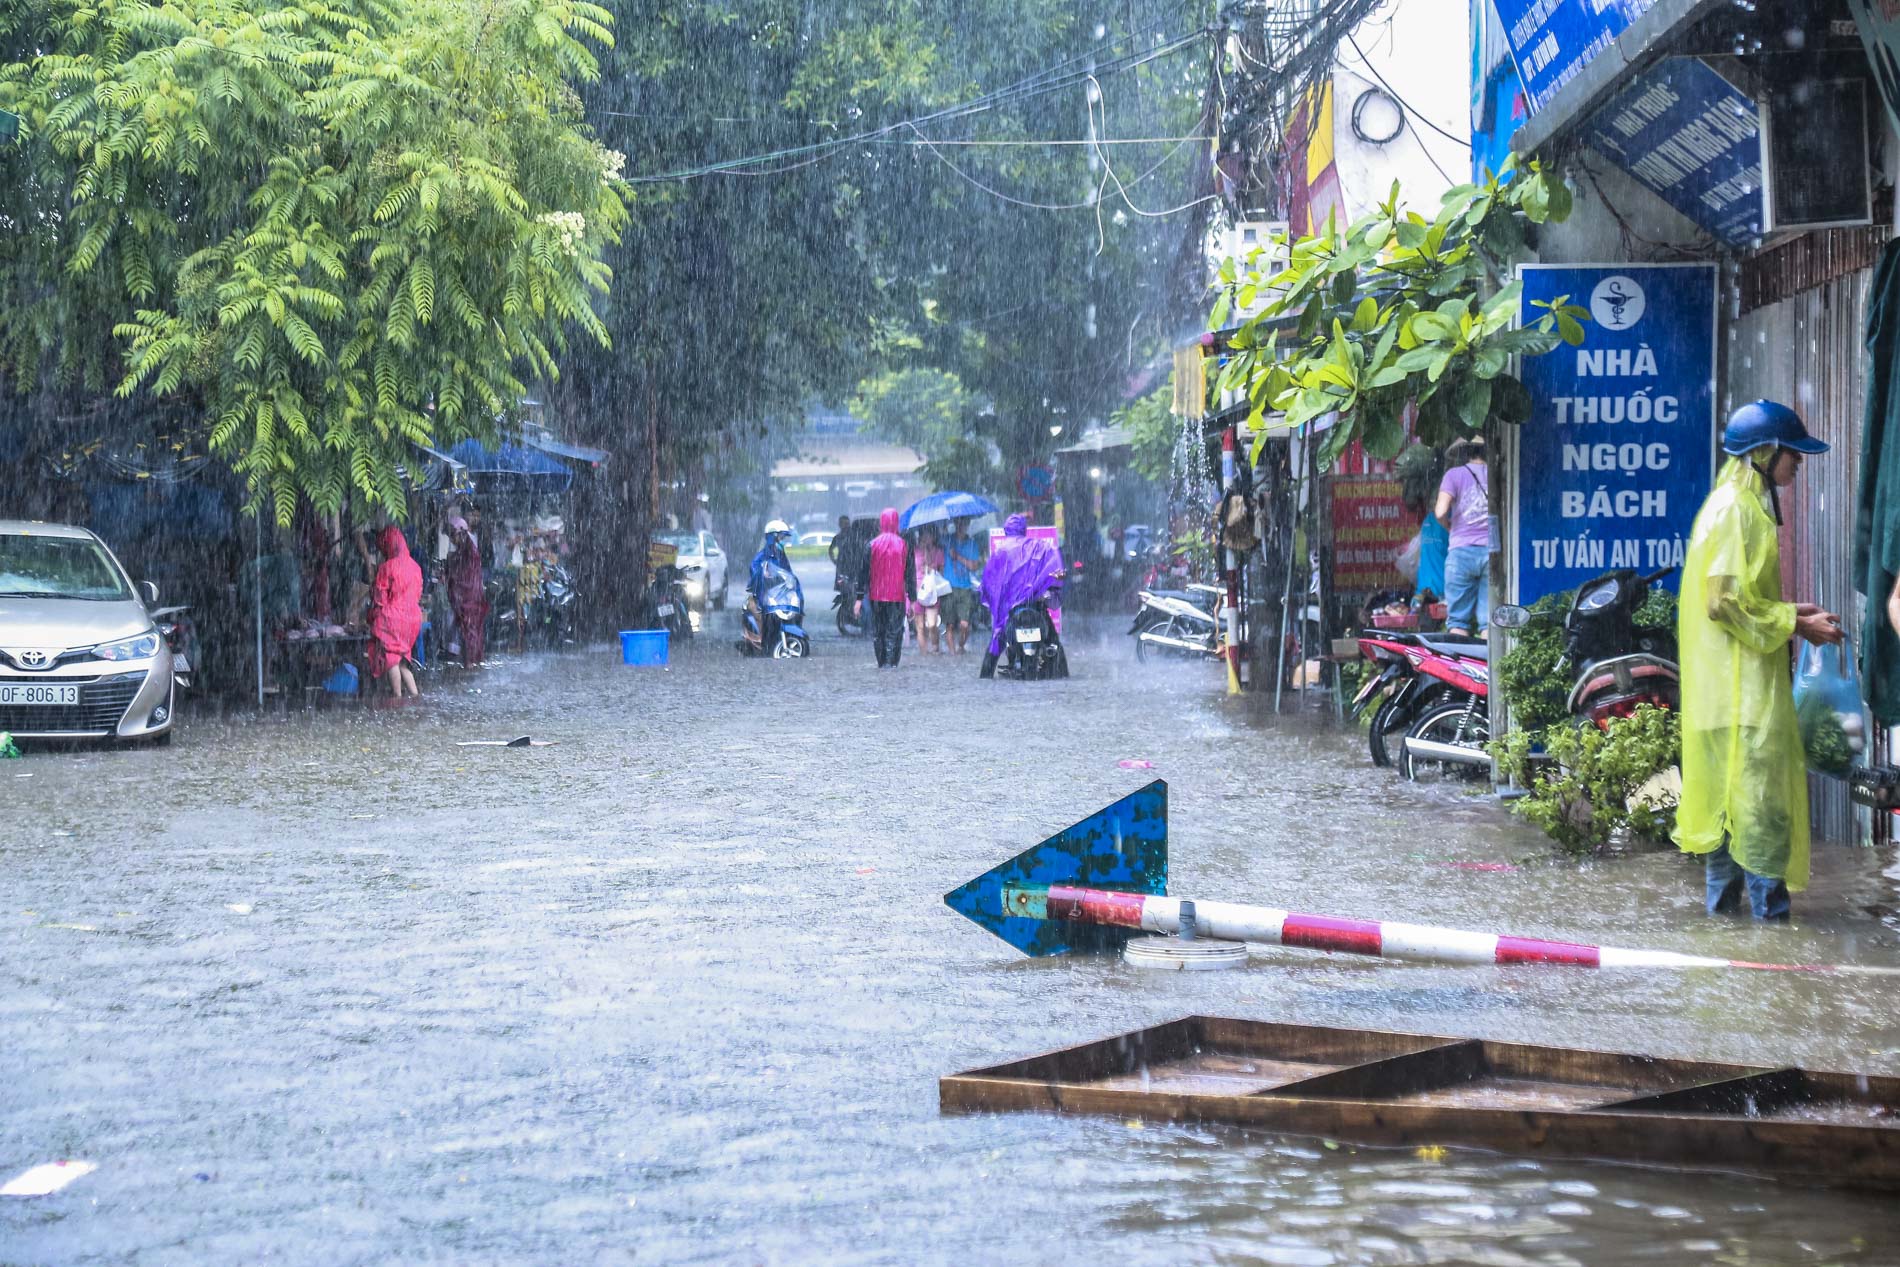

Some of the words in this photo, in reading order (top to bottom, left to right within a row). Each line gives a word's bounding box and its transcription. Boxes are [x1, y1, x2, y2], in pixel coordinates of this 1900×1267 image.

[1672, 119, 1733, 163] NGỌC
[1703, 95, 1760, 143] BÁCH
[1576, 343, 1659, 377] NHÀ
[1552, 387, 1678, 424] THUỐC
[1562, 443, 1670, 476] NGỌC
[1561, 485, 1667, 518] BÁCH
[1531, 537, 1559, 568] TƯ
[1563, 529, 1604, 568] VẤN
[1610, 539, 1640, 568] AN
[1646, 532, 1690, 568] TOÀ
[0, 687, 76, 702] 0F-806.13
